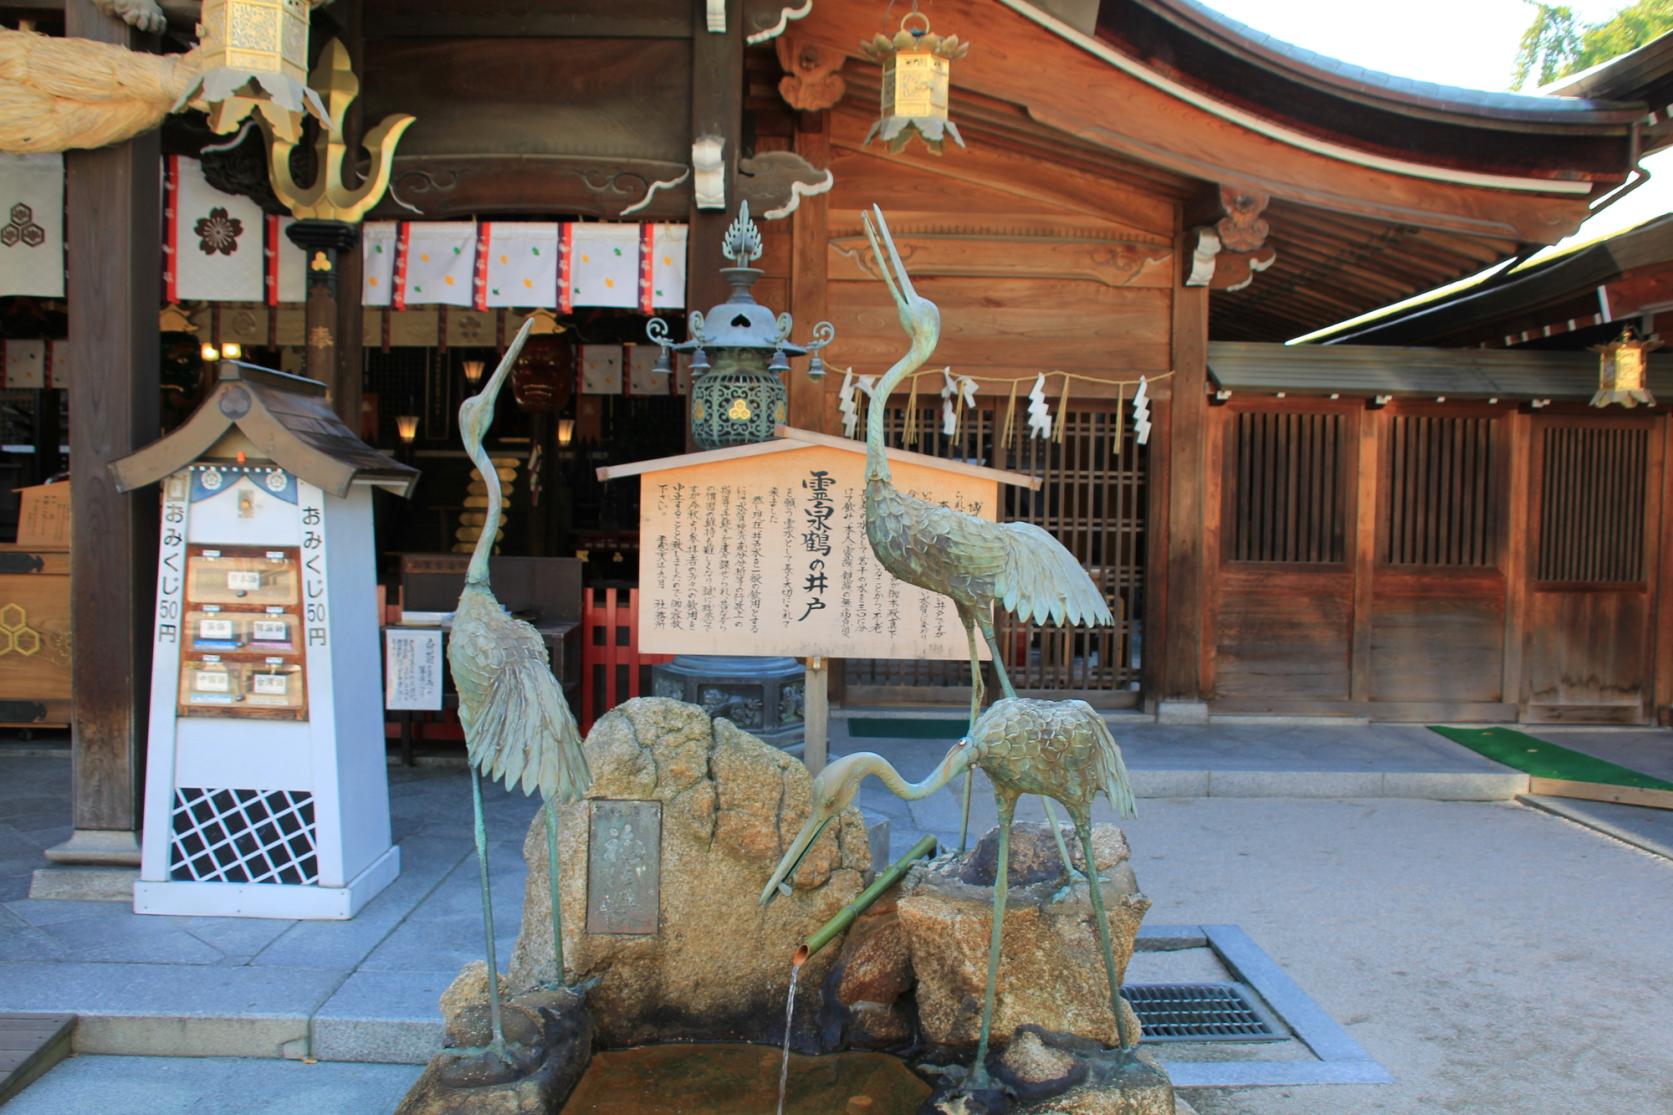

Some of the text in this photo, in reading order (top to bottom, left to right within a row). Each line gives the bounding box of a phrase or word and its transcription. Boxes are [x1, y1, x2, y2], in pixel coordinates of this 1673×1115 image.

[159, 504, 184, 643] おみくじ50円
[302, 506, 326, 646] おみくじ50円
[798, 470, 836, 622] 霊泉鶴の井戸
